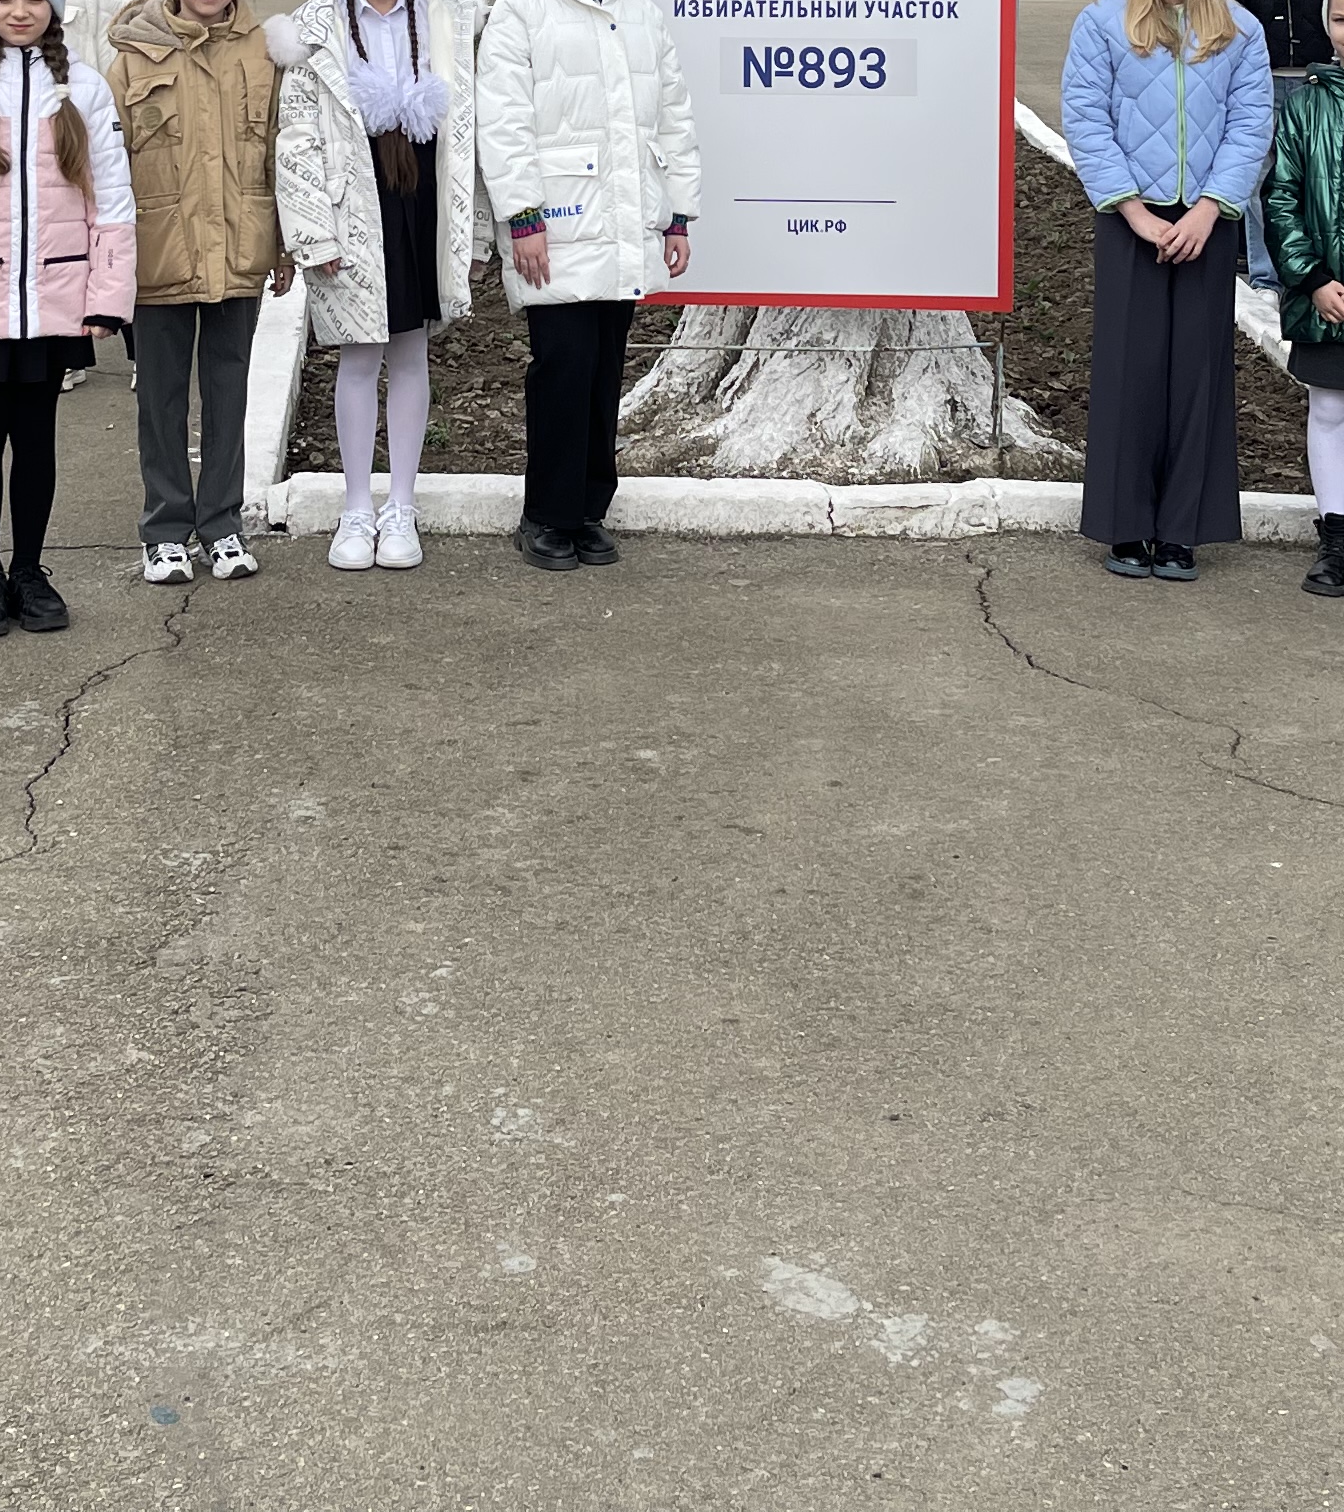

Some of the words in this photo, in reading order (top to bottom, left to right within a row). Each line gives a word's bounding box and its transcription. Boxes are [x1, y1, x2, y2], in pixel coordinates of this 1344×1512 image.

[864, 0, 960, 19] УЧАСТОК
[742, 45, 888, 90] №893
[543, 204, 584, 219] SMILE
[787, 219, 848, 236] ЦИК.РФ
